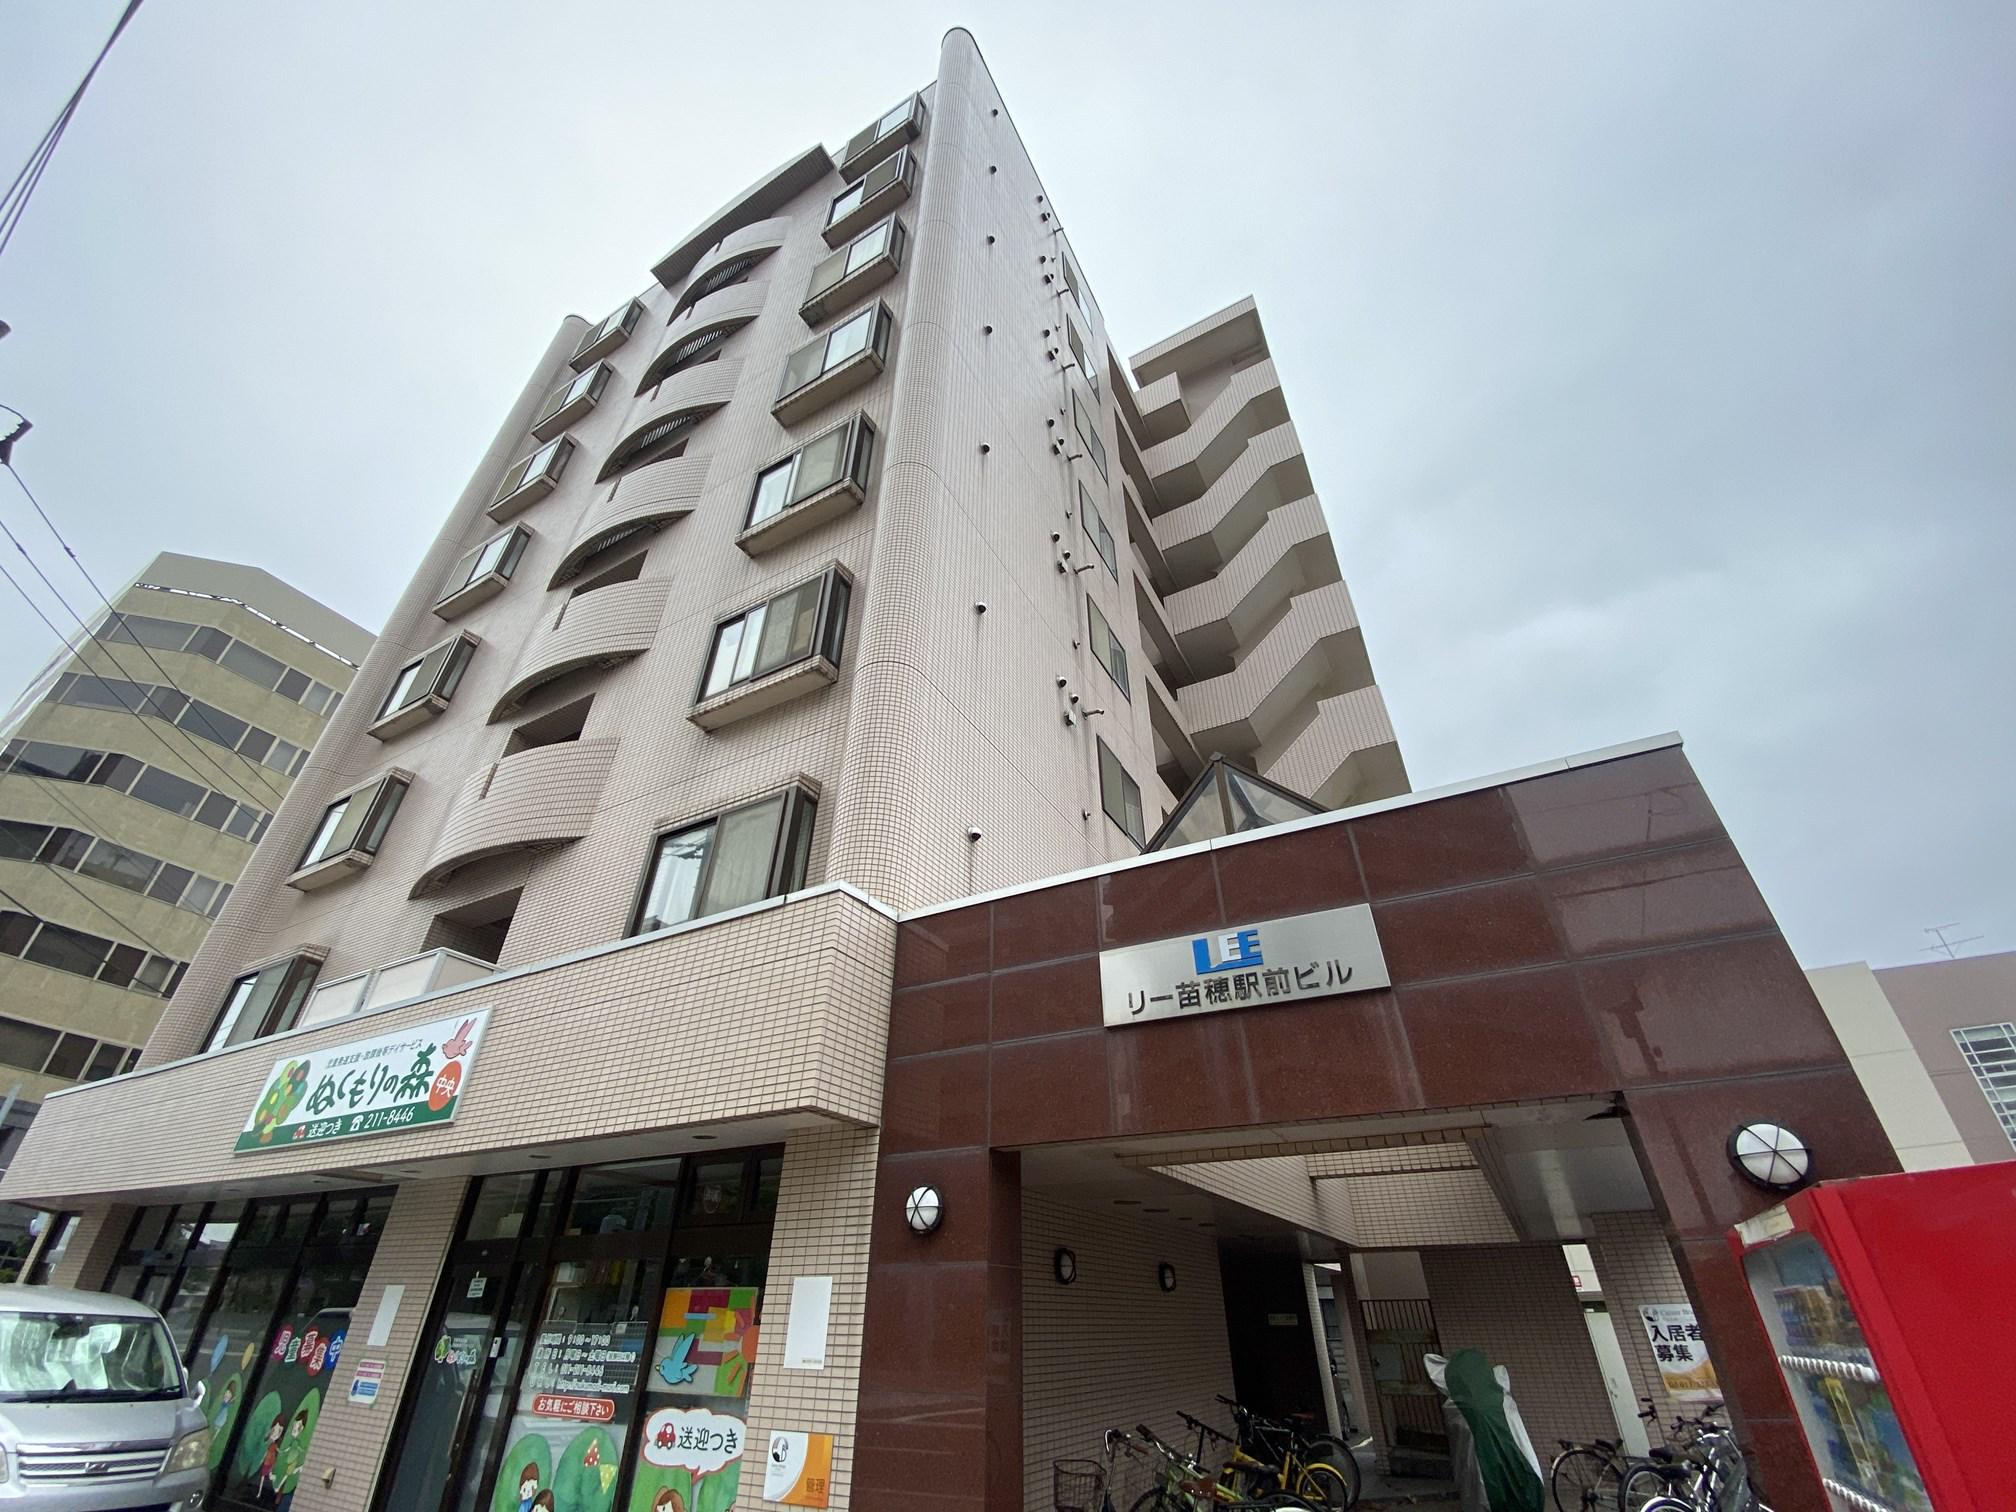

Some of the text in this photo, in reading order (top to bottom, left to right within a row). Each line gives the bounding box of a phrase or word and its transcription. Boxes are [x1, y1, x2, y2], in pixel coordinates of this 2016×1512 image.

[1192, 929, 1264, 975] LEE
[1128, 958, 1353, 1015] リー苗穂駅前ビル
[306, 1042, 437, 1115] ぬくもりの森
[436, 1075, 455, 1097] 中央
[306, 1118, 342, 1138] 送迎つき
[364, 1106, 416, 1129] 211-8446
[1651, 1323, 1702, 1342] 入居者
[1655, 1344, 1694, 1362] 募集
[537, 1397, 609, 1417] お気軽にご相談下さい
[677, 1426, 738, 1454] 送迎つき
